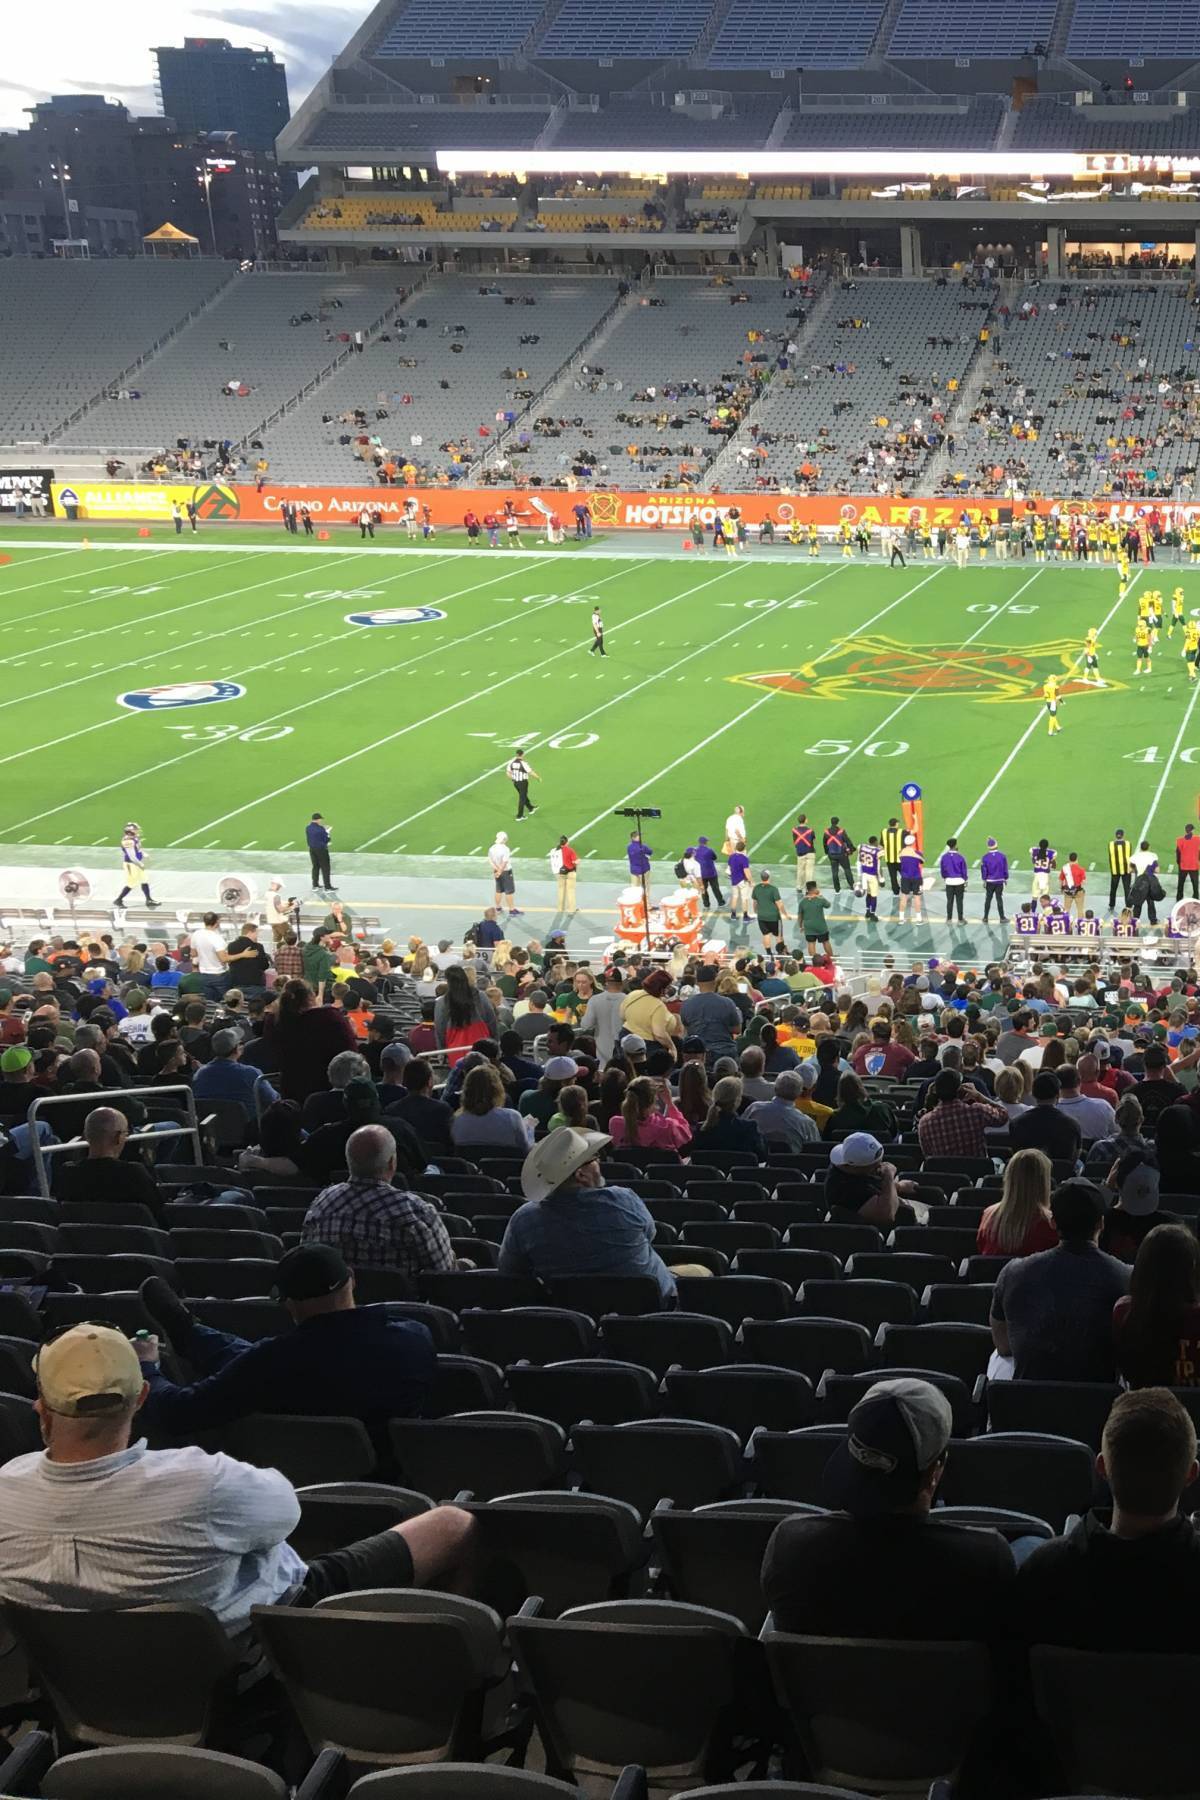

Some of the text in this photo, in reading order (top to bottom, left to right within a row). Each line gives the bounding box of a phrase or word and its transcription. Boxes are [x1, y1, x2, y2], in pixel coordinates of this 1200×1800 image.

[648, 497, 715, 505] ARIZONA
[182, 725, 294, 742] 30
[495, 732, 600, 750] 40
[804, 740, 911, 758] 50
[1020, 918, 1034, 932] 31
[1051, 920, 1066, 935] 21
[1080, 922, 1096, 936] 30
